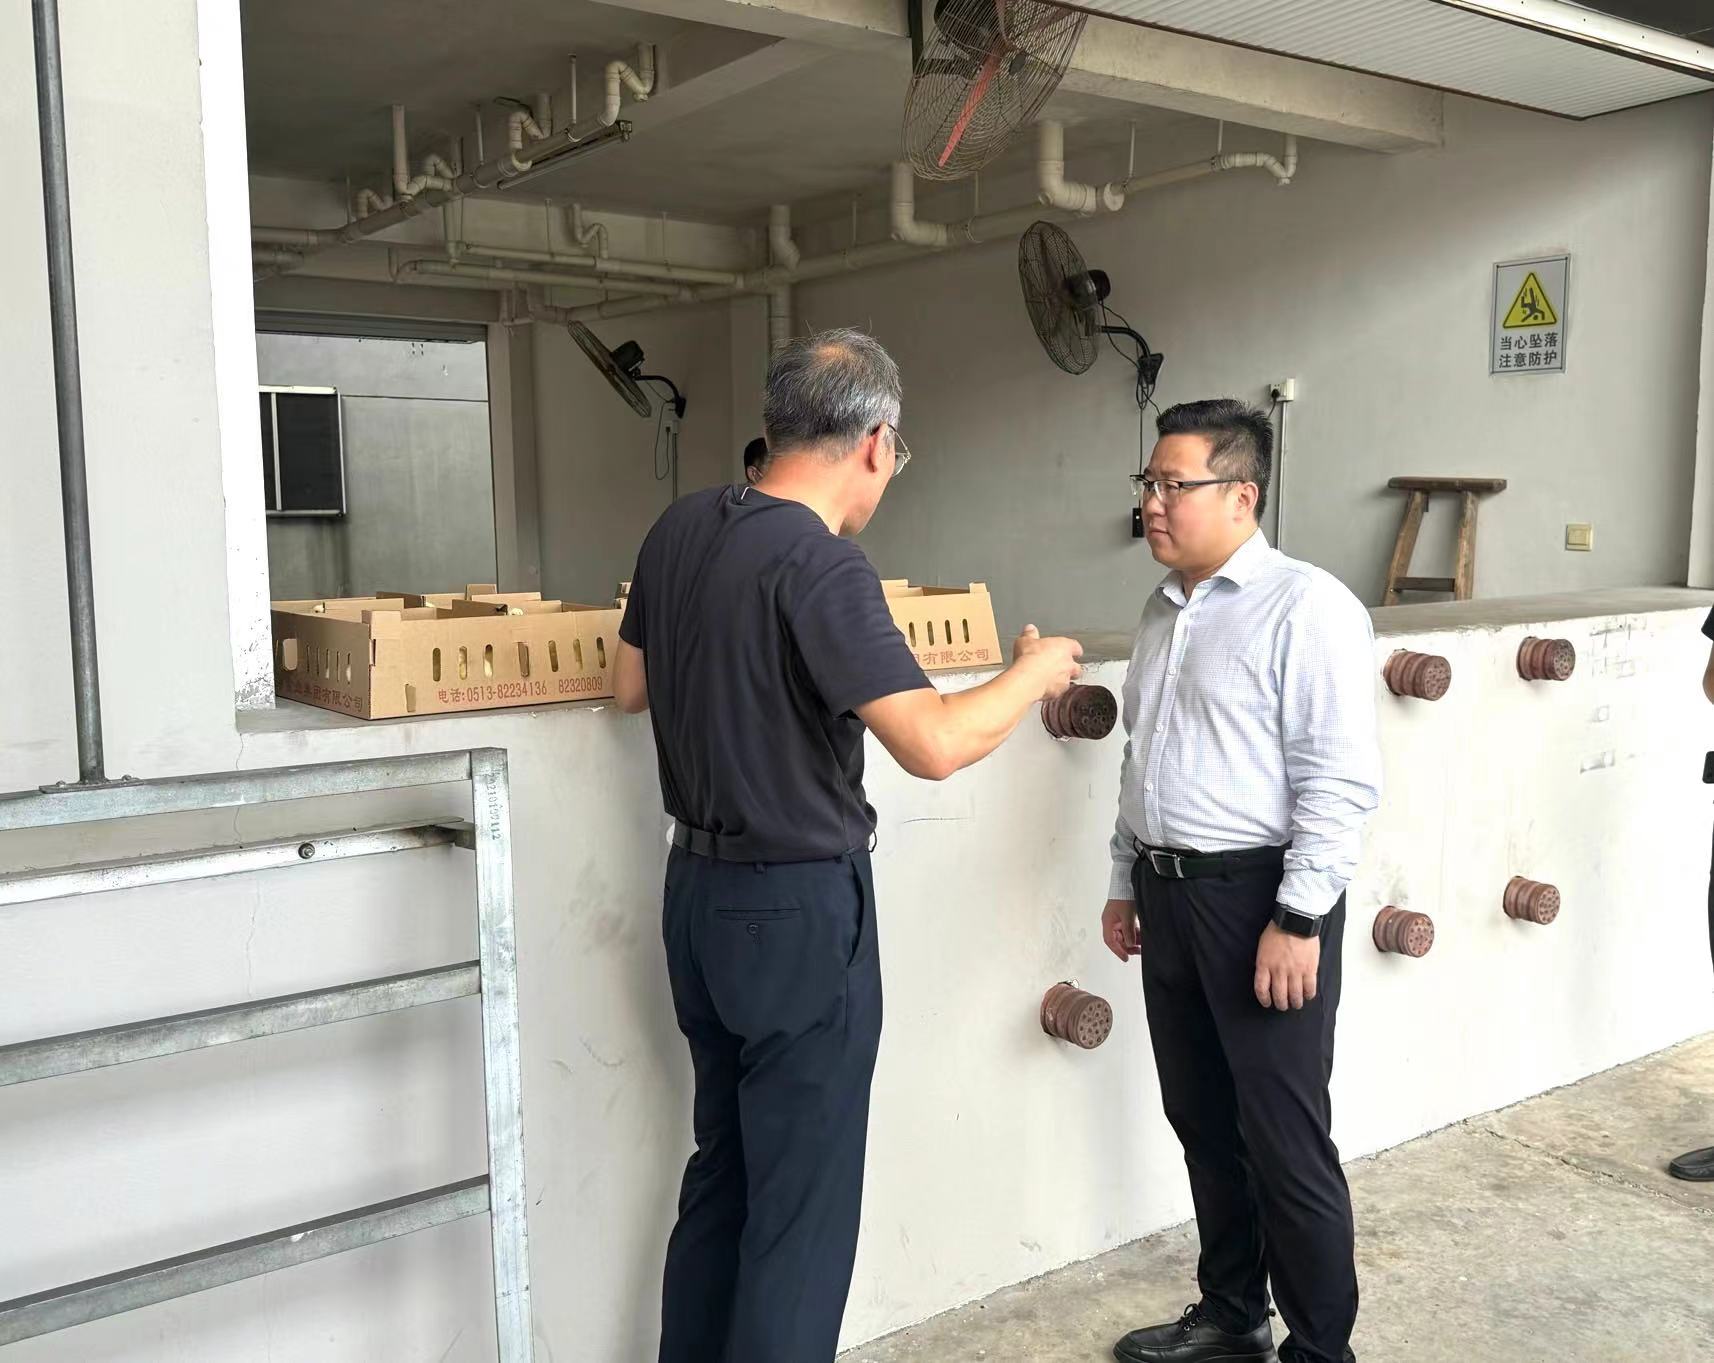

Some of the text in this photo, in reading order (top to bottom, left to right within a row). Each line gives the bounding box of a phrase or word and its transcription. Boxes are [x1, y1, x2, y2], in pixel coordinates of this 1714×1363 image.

[1500, 332, 1558, 350] 当心坠落
[1499, 350, 1557, 368] 注意防护
[558, 676, 603, 694] 82320809
